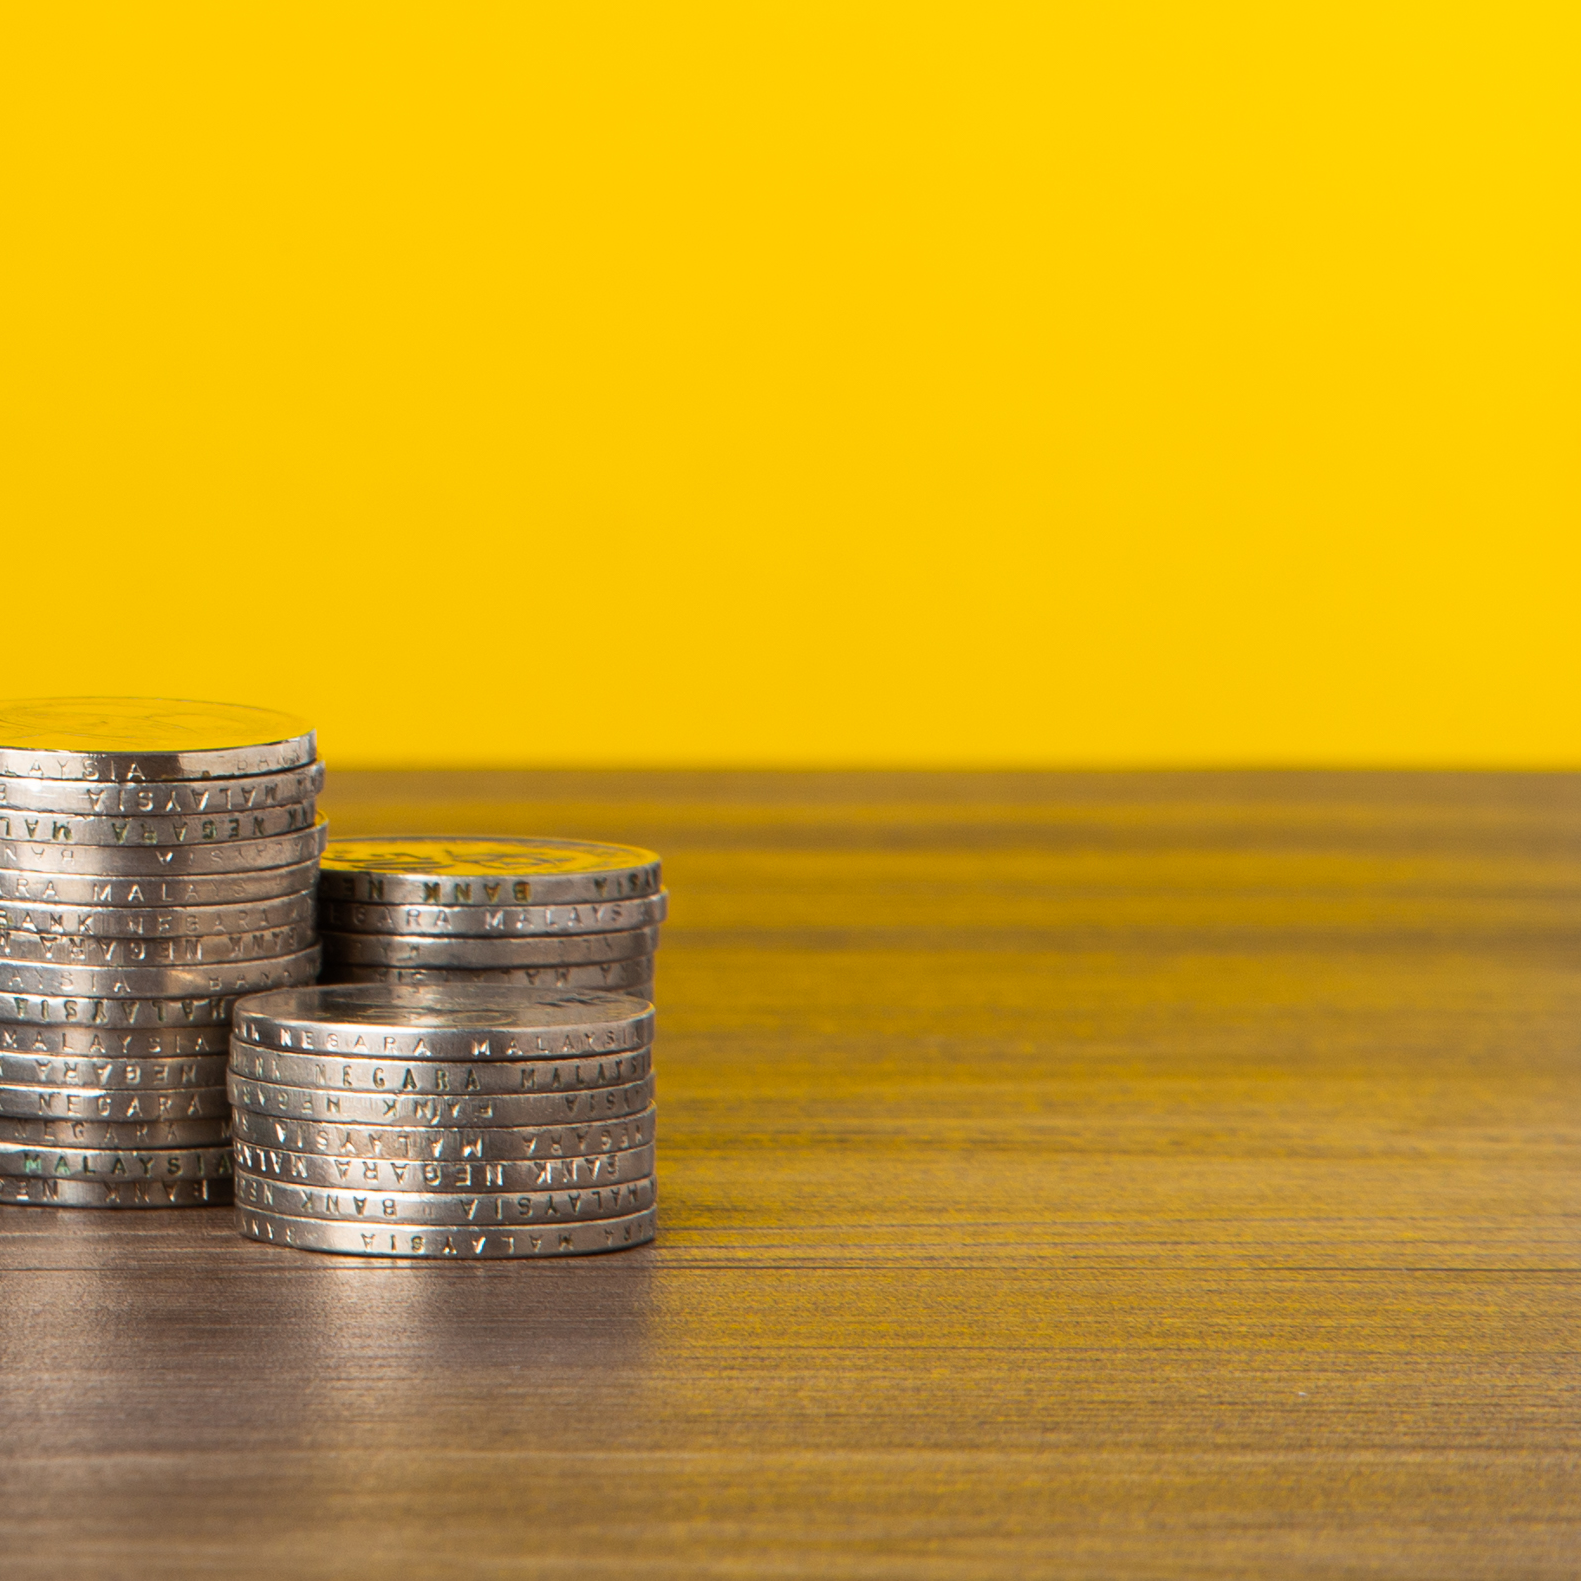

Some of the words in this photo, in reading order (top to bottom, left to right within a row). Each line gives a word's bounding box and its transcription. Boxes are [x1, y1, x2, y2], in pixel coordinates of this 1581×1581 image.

[87, 781, 279, 813] MALAYSIA
[111, 815, 267, 846] NEGARA
[423, 882, 531, 905] BANK
[39, 935, 203, 962] NEGARA
[1, 1028, 210, 1055] MALAYSIA
[279, 1028, 433, 1057] NEGARA
[35, 1058, 197, 1086] NEGARA
[314, 1064, 481, 1092] NEGARA
[38, 1091, 203, 1119] NEGARA
[274, 1121, 484, 1159] MALAYSIA
[522, 1126, 644, 1156] NEGARA
[22, 1150, 233, 1178] MALAYSIA
[334, 1159, 504, 1187] NEGARA
[534, 1154, 619, 1185] BANK
[104, 1178, 210, 1204] BANK
[299, 1189, 399, 1218] BANK
[459, 1184, 639, 1221] MALAYSIA
[360, 1231, 575, 1255] MALAYSIA
